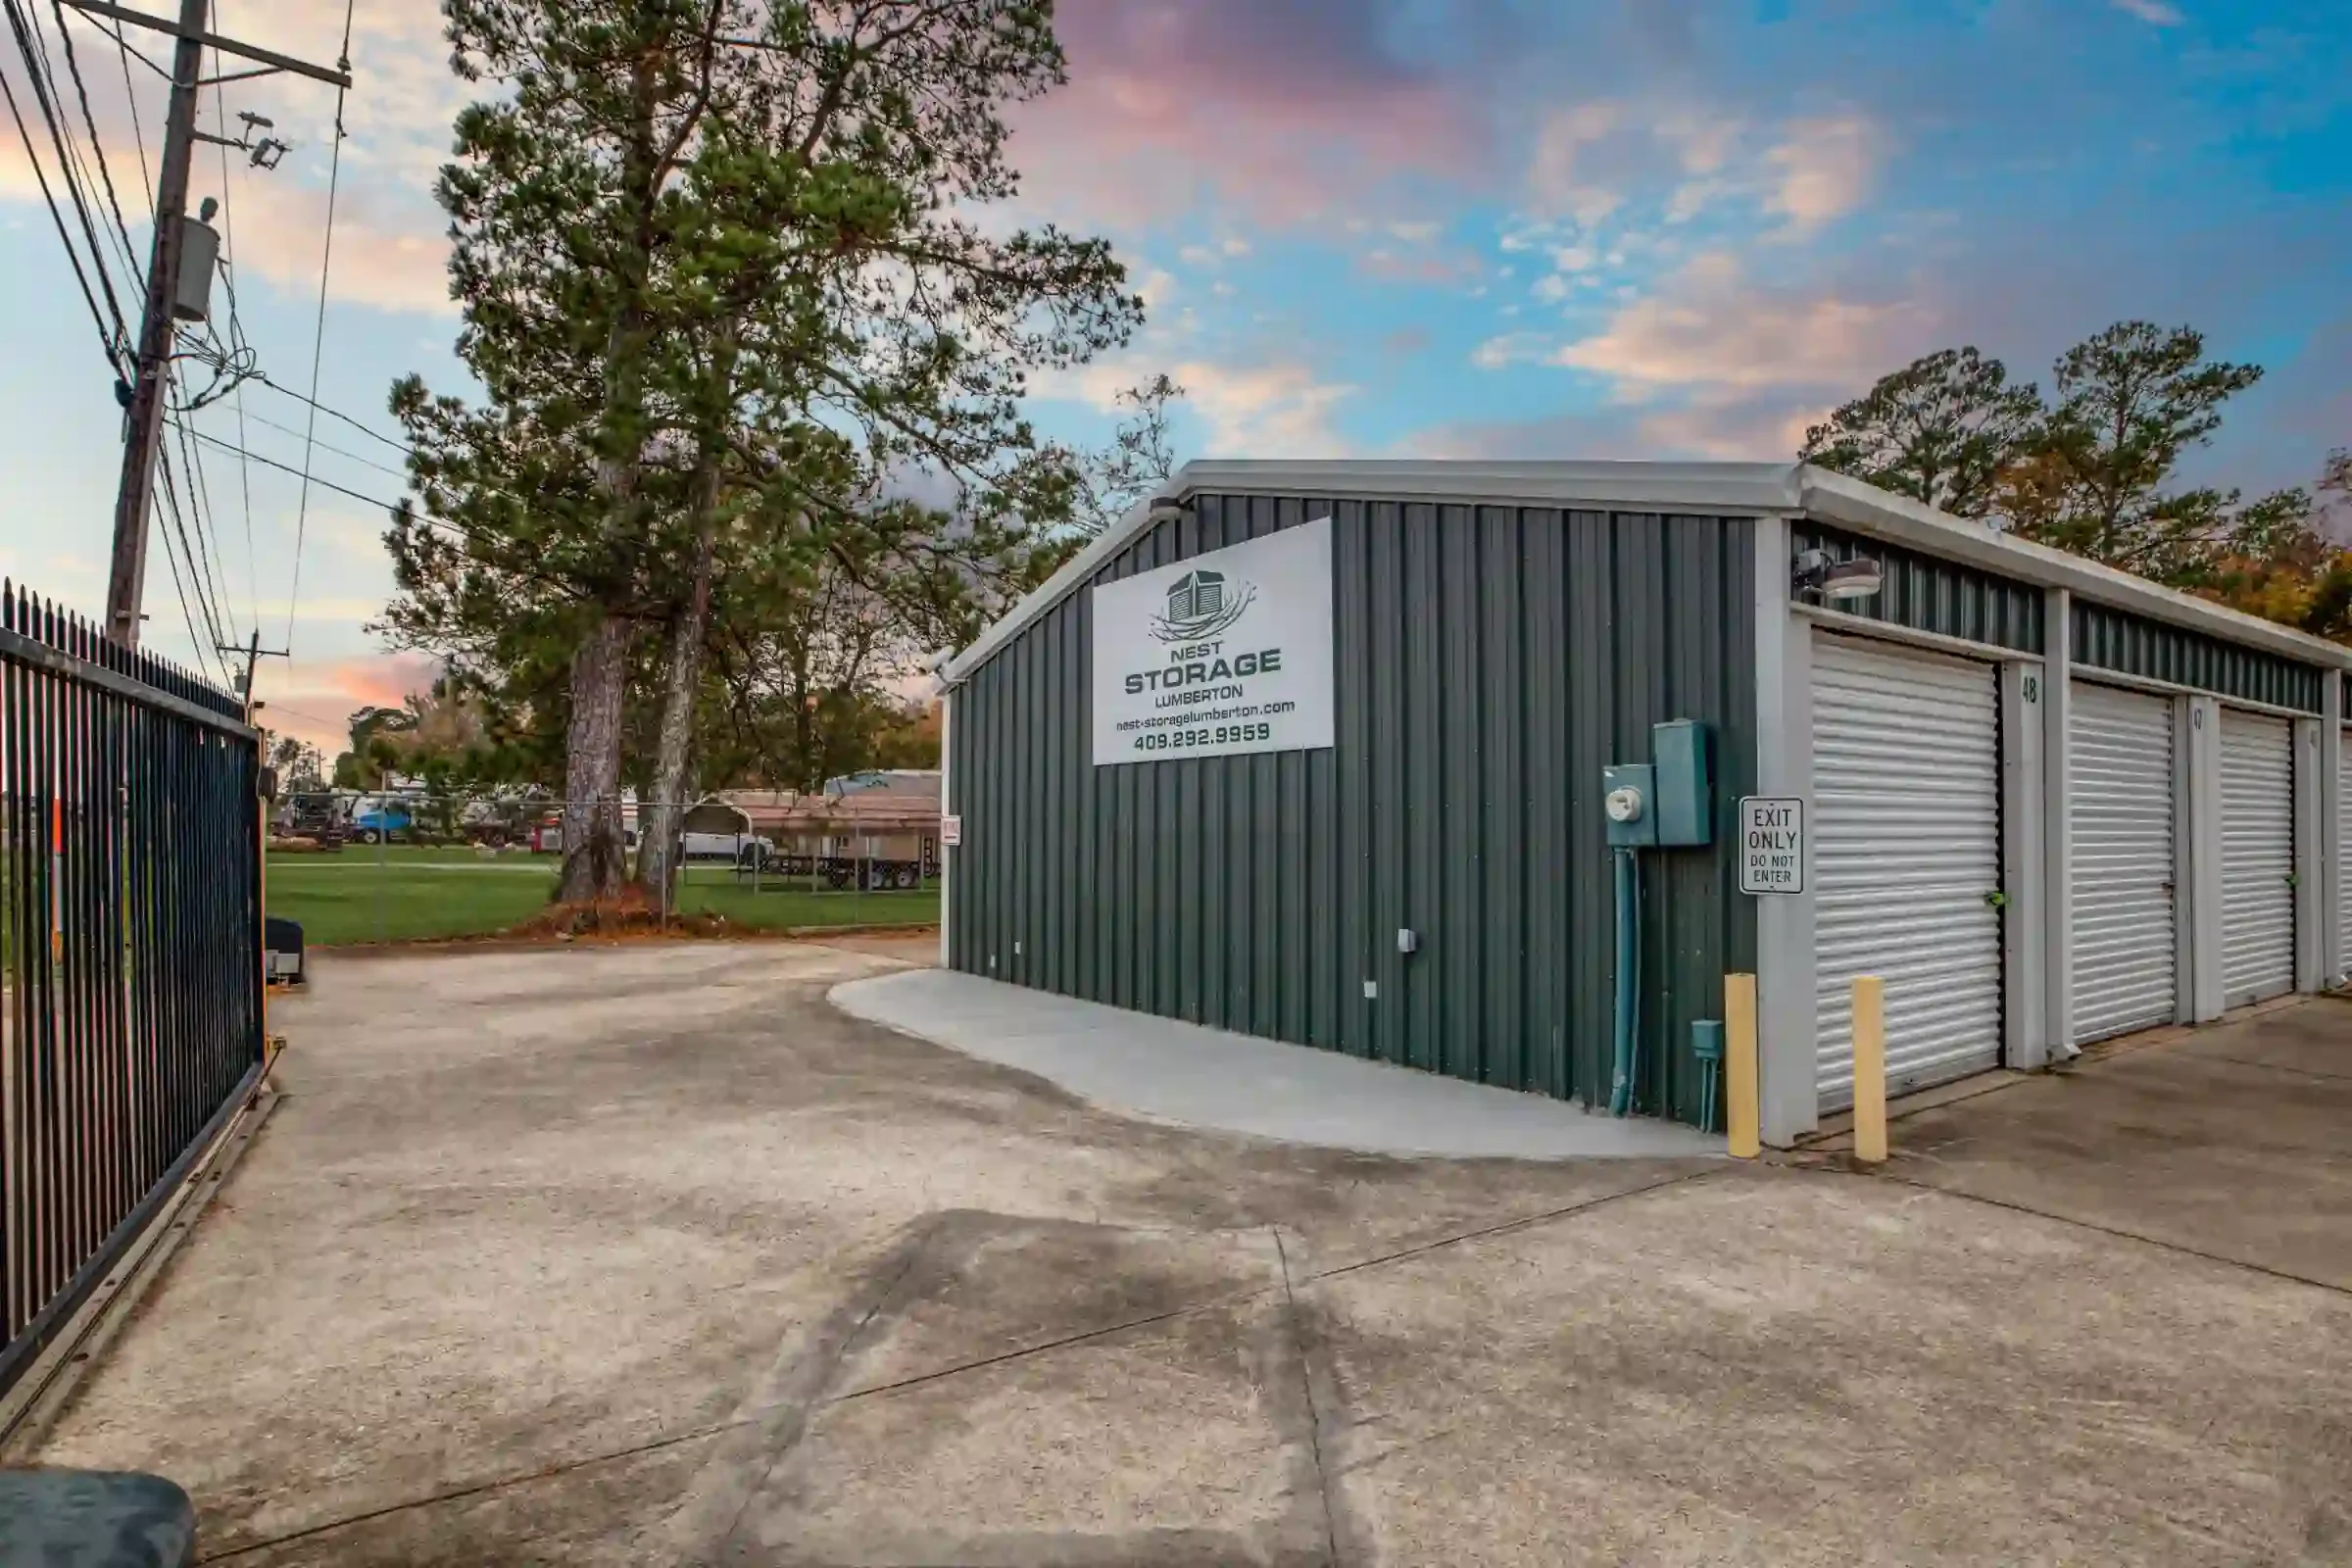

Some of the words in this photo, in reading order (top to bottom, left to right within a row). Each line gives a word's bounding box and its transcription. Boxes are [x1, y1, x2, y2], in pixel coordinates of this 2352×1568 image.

[1171, 640, 1224, 662] NEST
[1125, 648, 1282, 695] STORAGE
[1155, 684, 1244, 709] LUMBERTON
[2023, 676, 2036, 703] 48
[1134, 722, 1270, 751] 409.292.9959
[1754, 809, 1791, 826] EXIT
[1749, 831, 1796, 850] ONLY
[1750, 855, 1766, 867] DO
[1772, 855, 1795, 867] NOT
[1753, 869, 1791, 883] ENTER
